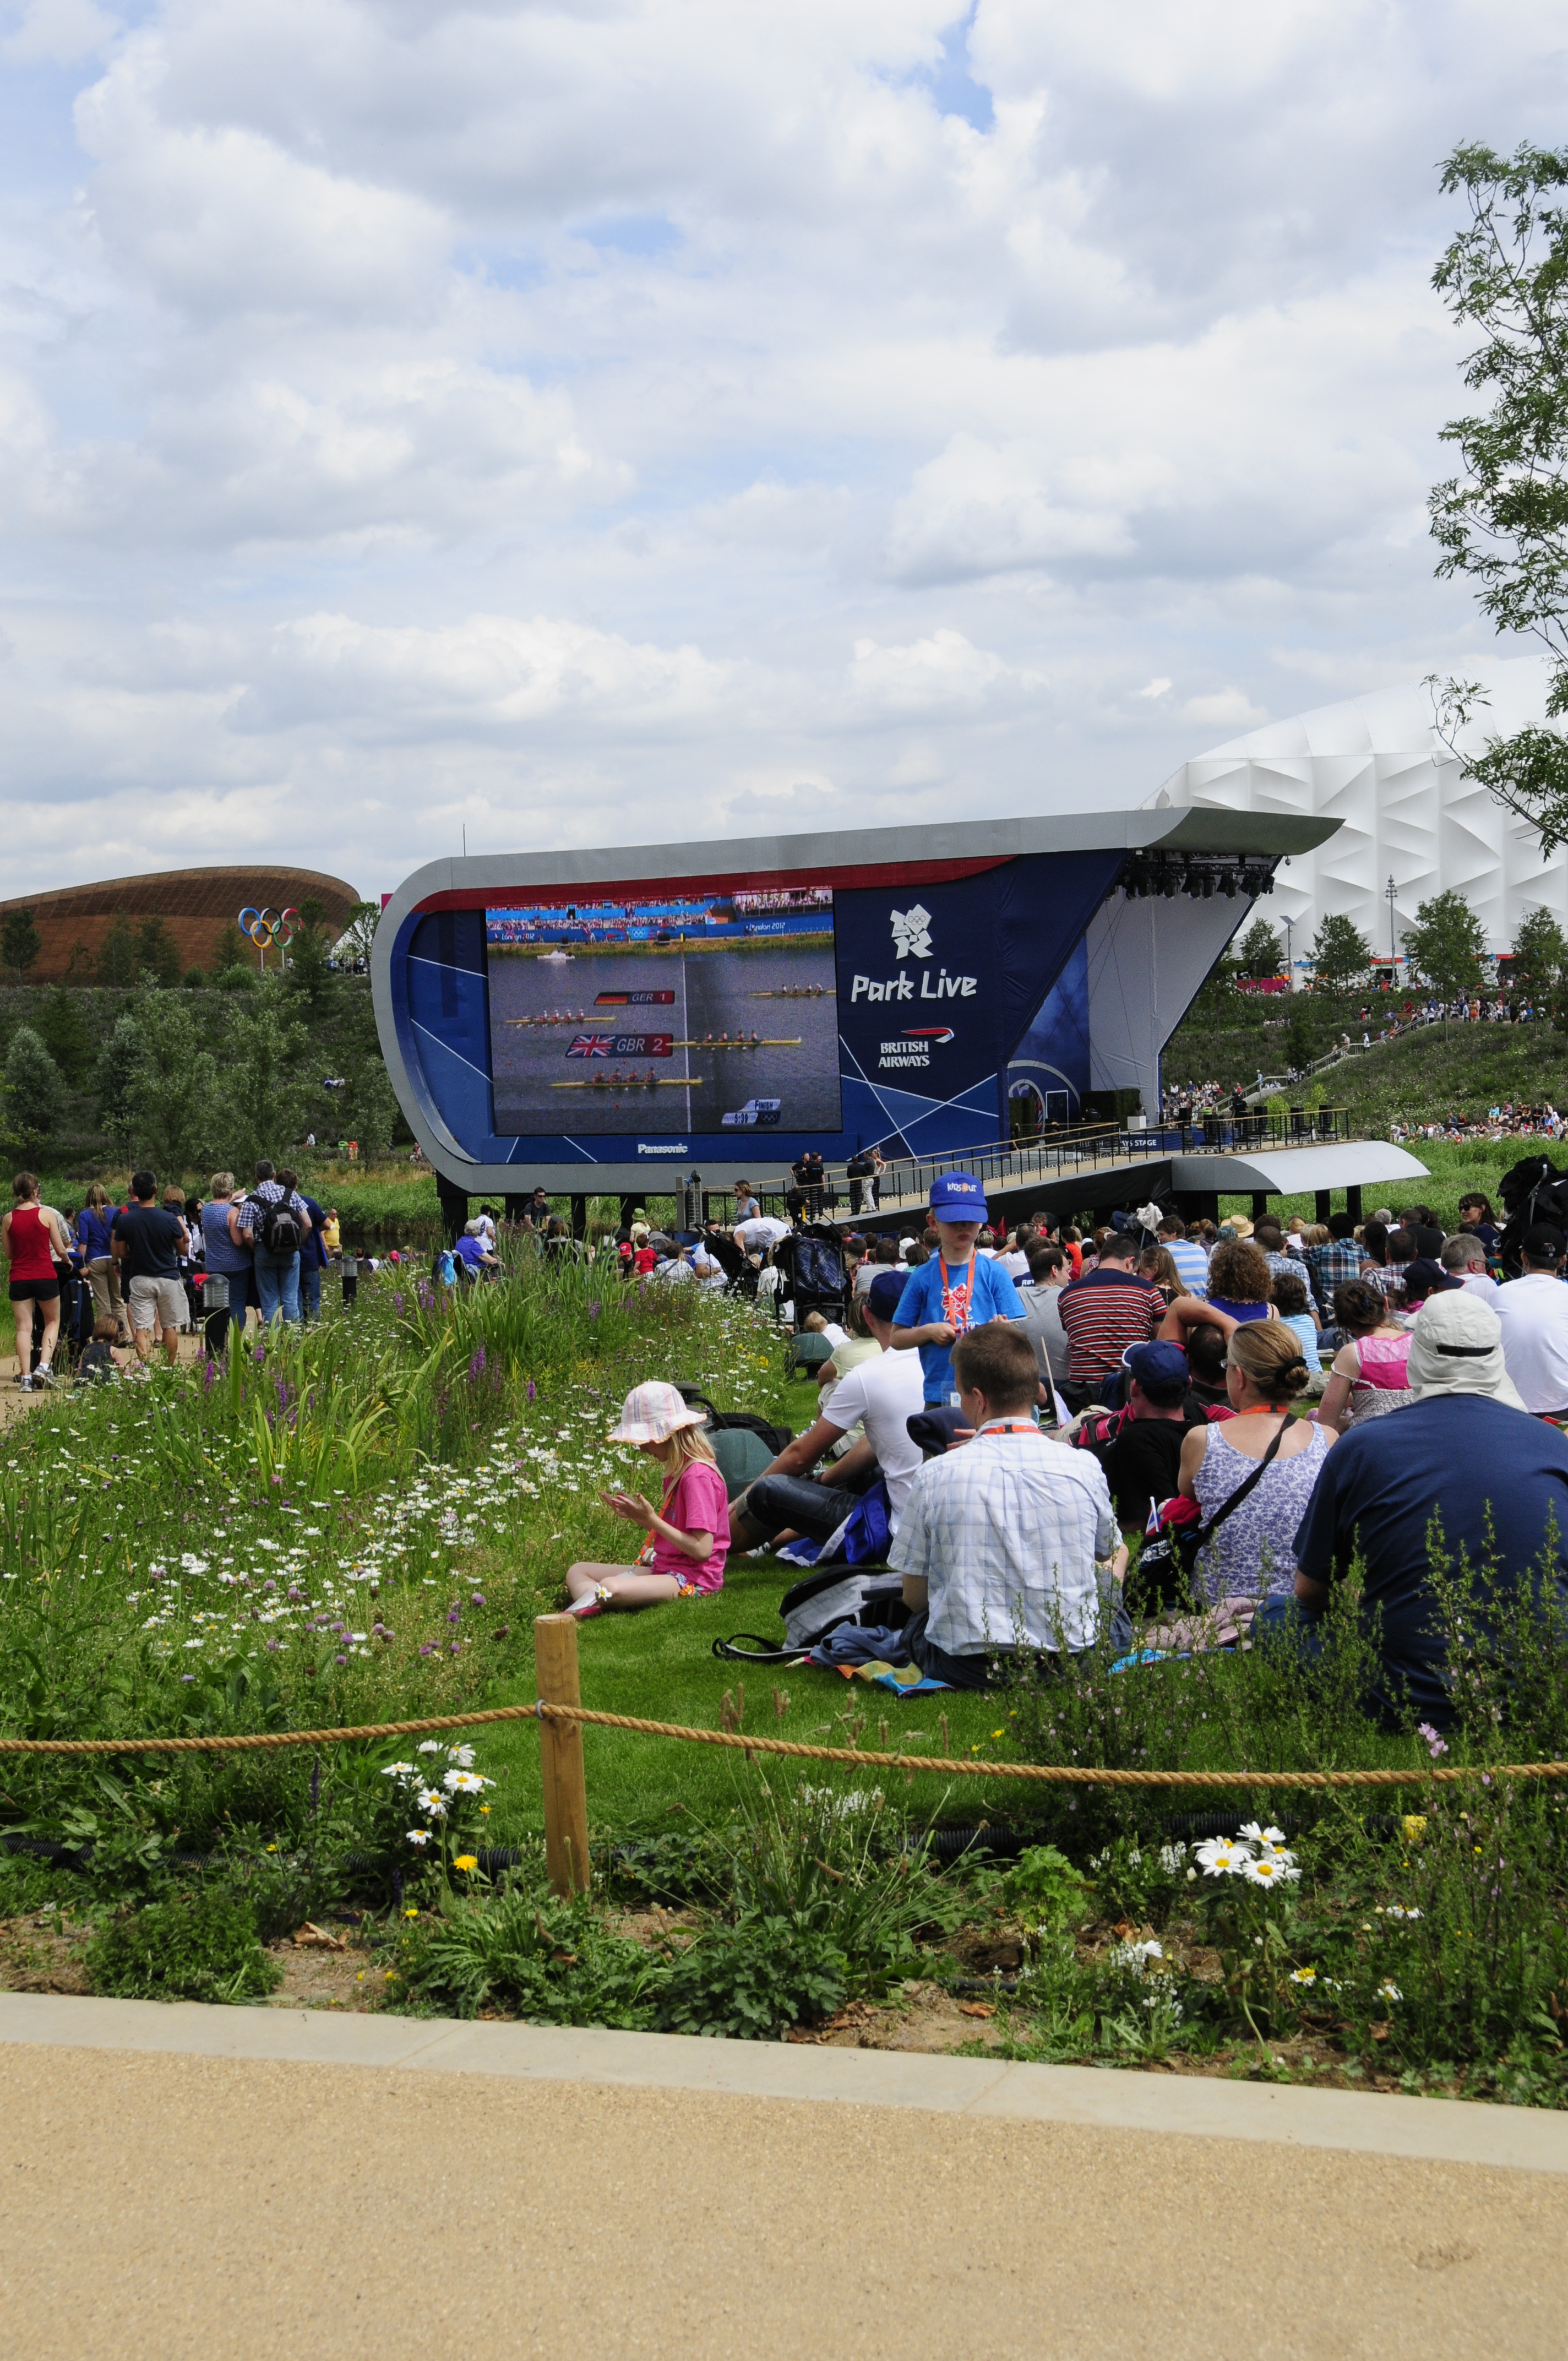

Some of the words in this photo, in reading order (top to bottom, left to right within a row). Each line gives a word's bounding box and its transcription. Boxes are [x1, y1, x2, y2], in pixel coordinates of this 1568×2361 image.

[851, 971, 914, 1003] Park
[921, 969, 977, 998] Live
[632, 993, 654, 1002] GER
[617, 1038, 645, 1052] GBR
[652, 1038, 663, 1052] 2
[880, 1041, 929, 1054] BRITISH
[878, 1055, 930, 1068] AIRWAYS
[734, 1113, 749, 1124] 5:39
[638, 1143, 688, 1154] Panasonic
